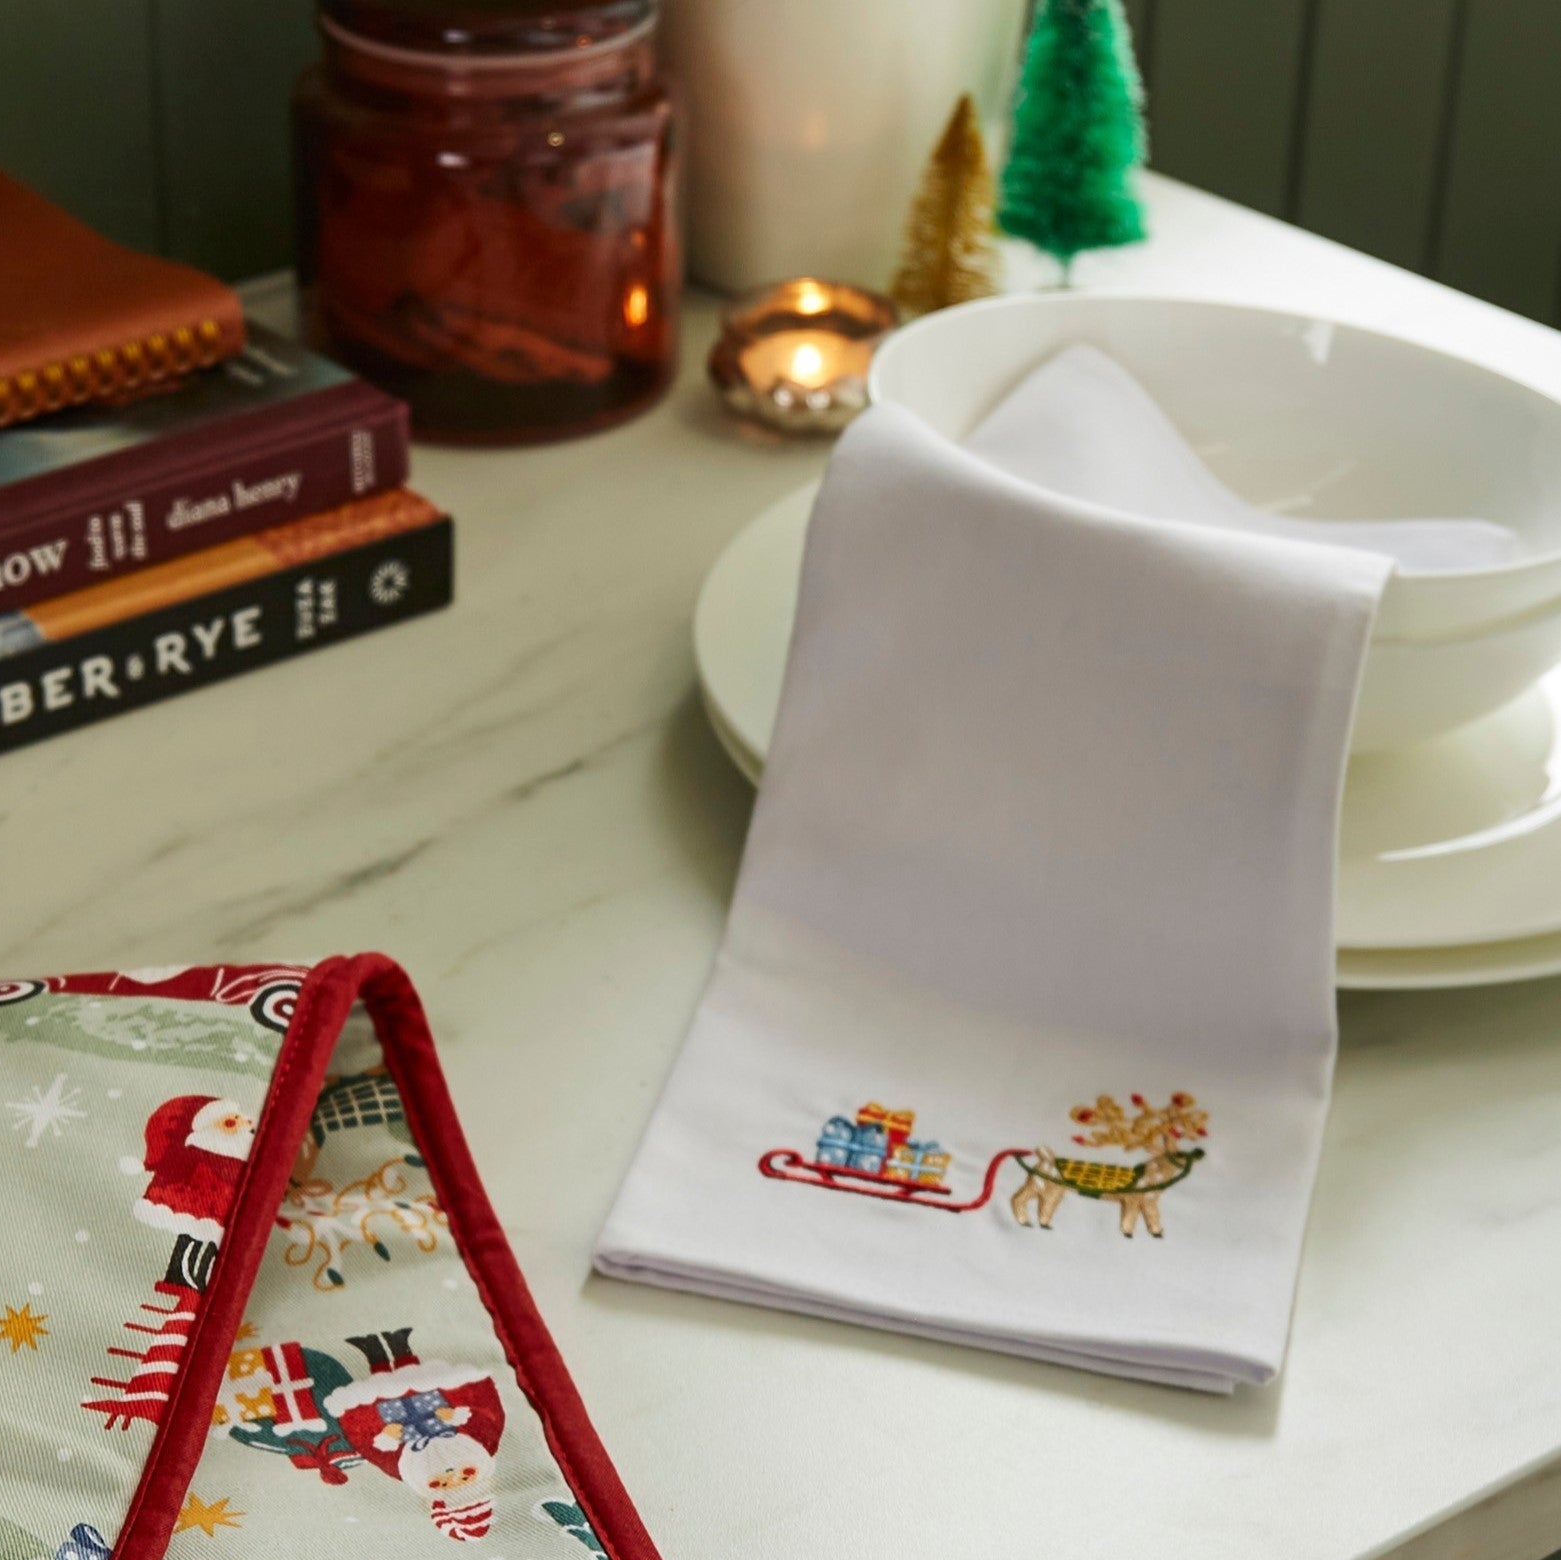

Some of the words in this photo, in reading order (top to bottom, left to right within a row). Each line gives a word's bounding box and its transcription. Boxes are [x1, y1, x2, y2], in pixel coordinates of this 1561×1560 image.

[165, 493, 231, 531] diana
[231, 472, 302, 510] henry
[153, 606, 264, 675] RYE
